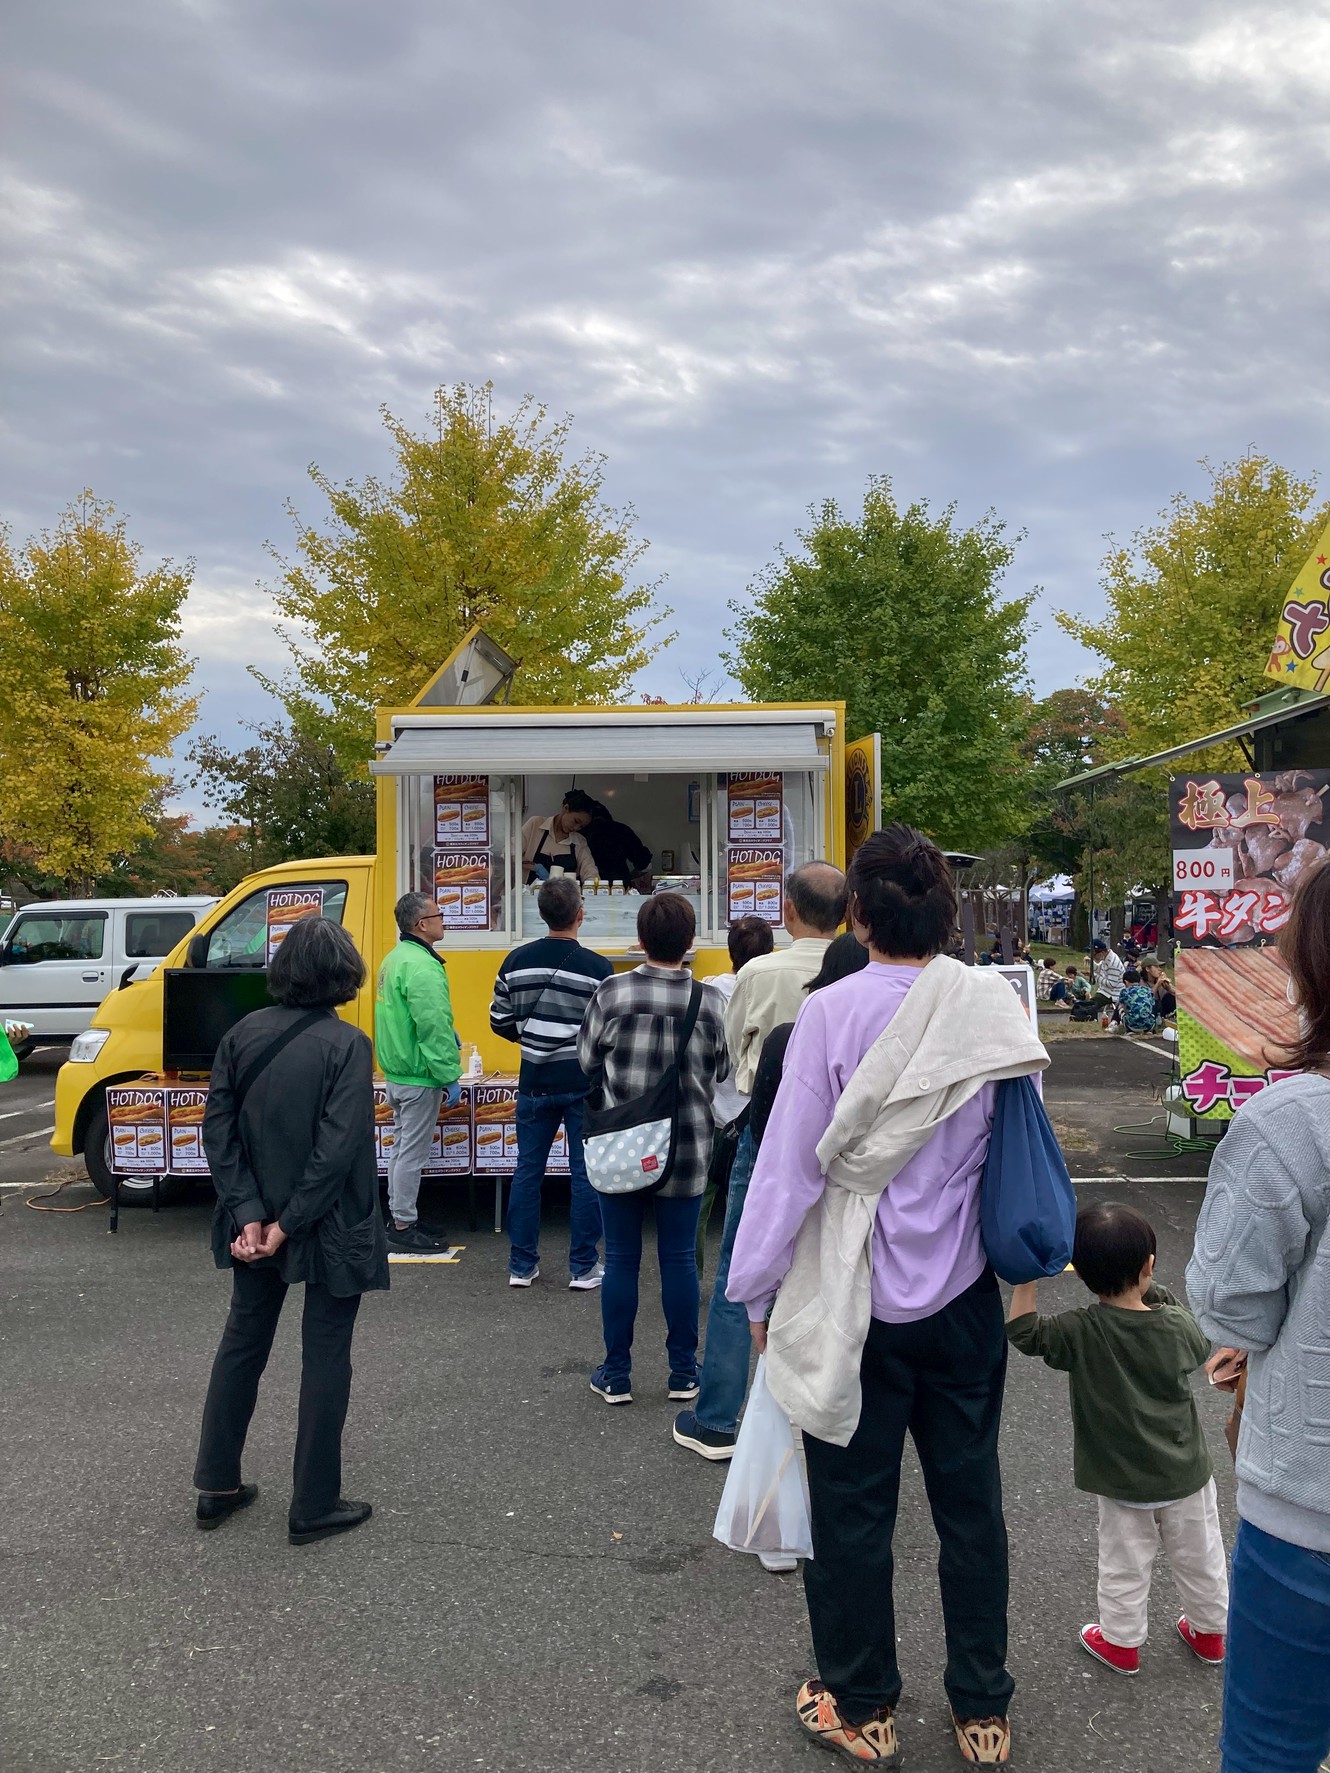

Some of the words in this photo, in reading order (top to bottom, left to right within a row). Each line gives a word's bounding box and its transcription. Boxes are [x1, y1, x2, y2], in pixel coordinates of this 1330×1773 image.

[1178, 779, 1281, 830] 極上
[437, 855, 487, 869] HOTDOG
[730, 850, 781, 865] HOTDOG
[270, 893, 320, 907] HOTDOG
[1174, 889, 1292, 938] 牛タン
[111, 1092, 163, 1107] HOTDOG
[171, 1092, 208, 1107] HOTD
